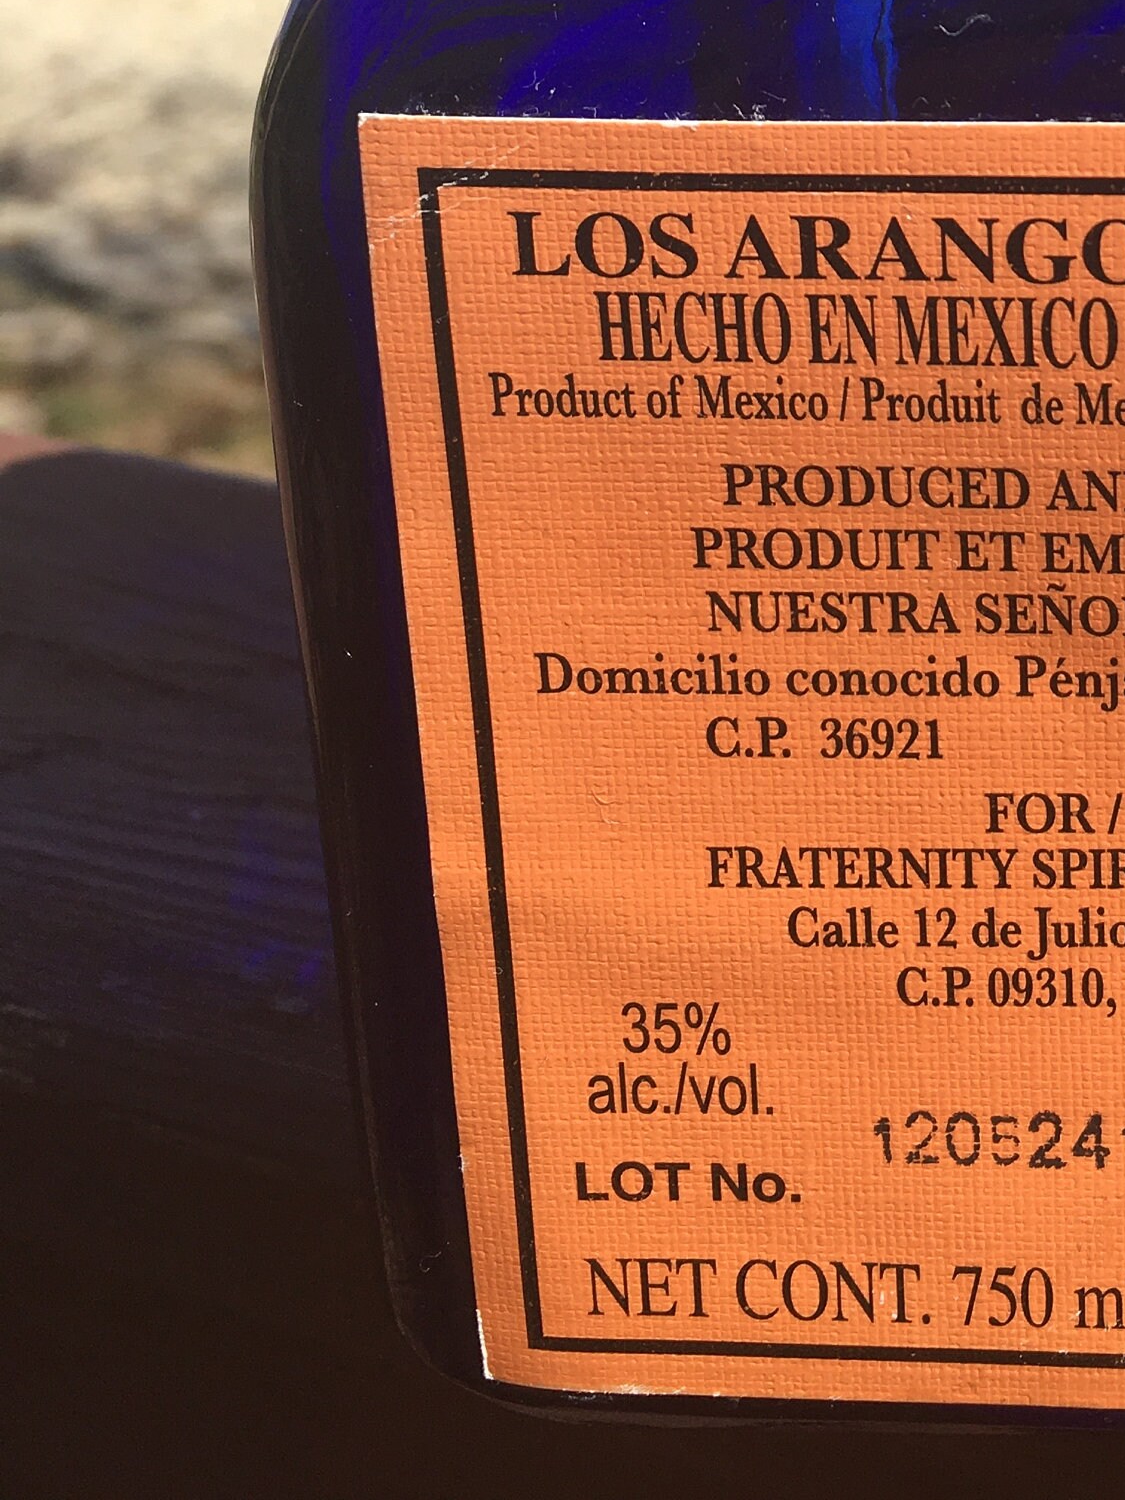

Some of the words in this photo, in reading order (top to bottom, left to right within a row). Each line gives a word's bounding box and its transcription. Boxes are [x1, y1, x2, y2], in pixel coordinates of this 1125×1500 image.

[507, 212, 698, 278] LOS
[593, 291, 791, 364] HECHO
[805, 295, 877, 365] EN
[892, 296, 1118, 370] MEXICO
[488, 372, 636, 418] Product
[647, 375, 684, 418] of
[694, 375, 828, 420] Mexico
[860, 377, 1001, 423] Produit
[1022, 383, 1063, 425] de
[721, 464, 1030, 509] PRODUCED
[691, 528, 939, 570] PRODUIT
[955, 531, 1025, 571] ET
[706, 592, 960, 633] NUESTRA
[534, 653, 770, 695] Domicilio
[786, 655, 999, 697] conocido
[707, 717, 790, 757] C.P.
[821, 719, 943, 760] 36921
[985, 793, 1095, 833] FOR
[706, 847, 1018, 888] FRATERNITY
[788, 907, 898, 948] Calle
[915, 908, 957, 948] 12
[972, 907, 1021, 947] de
[897, 967, 973, 1006] C.P.
[989, 968, 1116, 1017] 09310,
[622, 1002, 730, 1055] 35%
[589, 1062, 773, 1115] alc./vol.
[576, 1162, 690, 1201] LOT
[711, 1163, 800, 1202] No.
[586, 1259, 716, 1317] NET
[736, 1260, 930, 1324] CONT.
[953, 1267, 1053, 1327] 750
